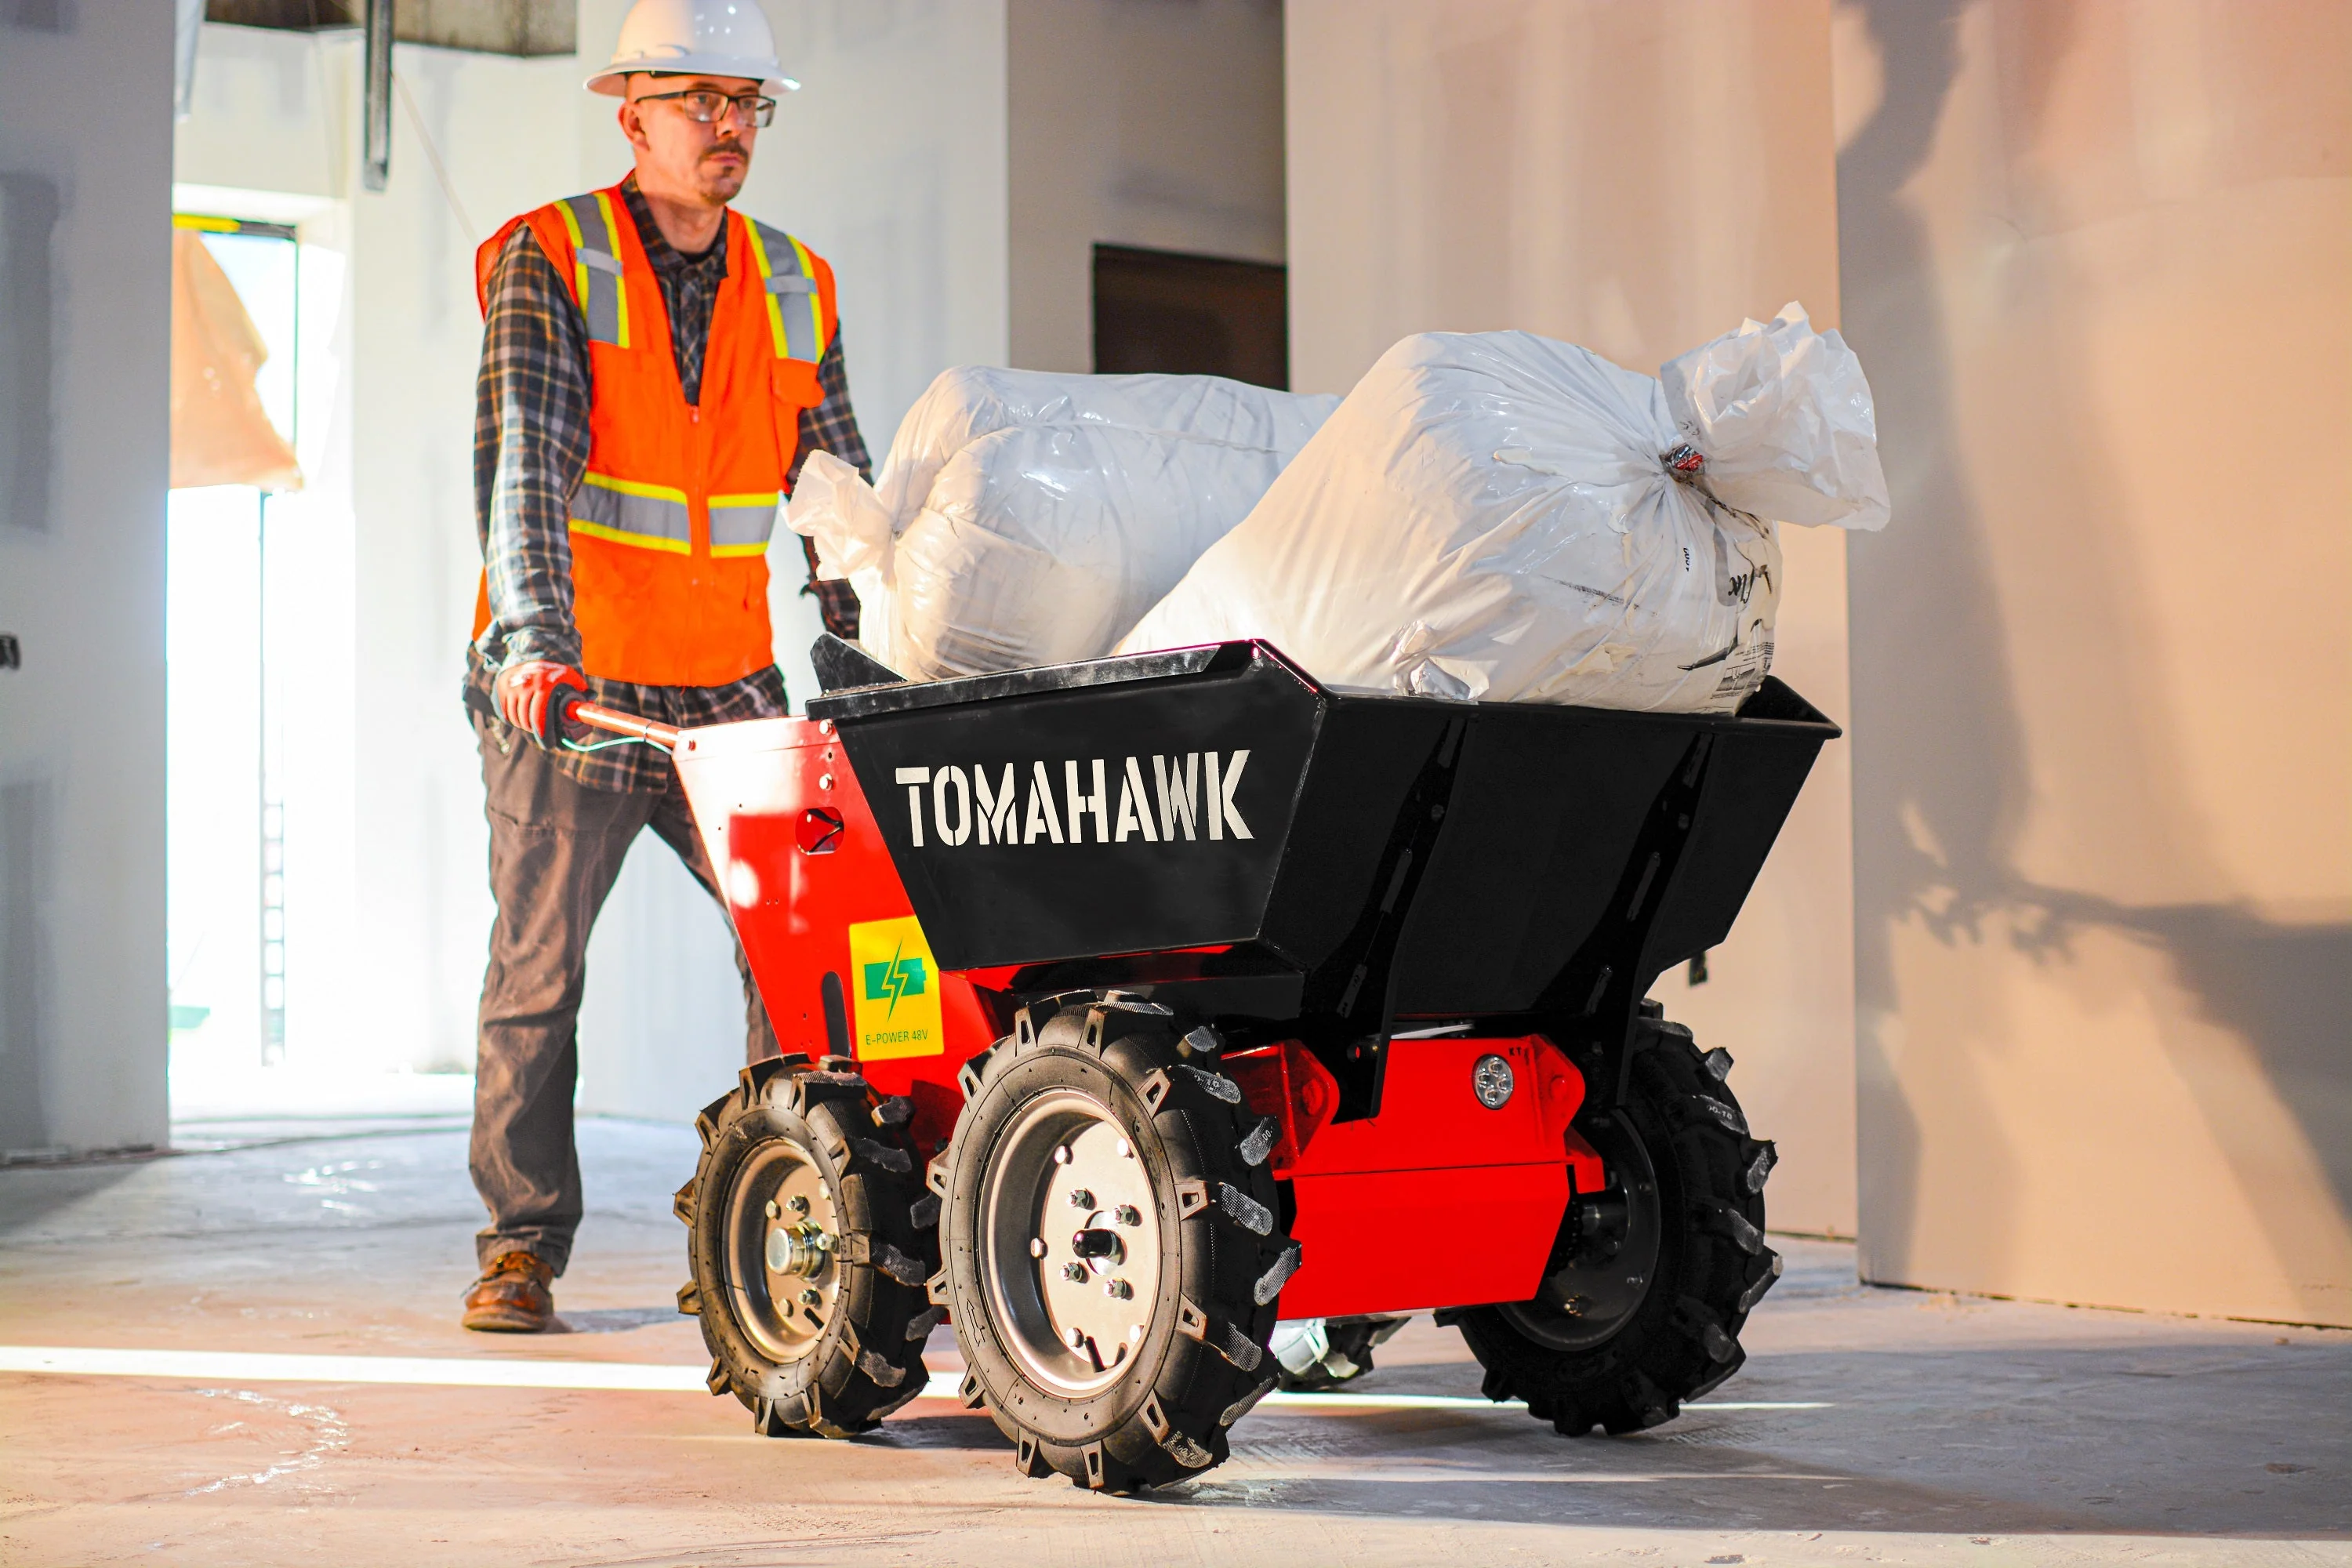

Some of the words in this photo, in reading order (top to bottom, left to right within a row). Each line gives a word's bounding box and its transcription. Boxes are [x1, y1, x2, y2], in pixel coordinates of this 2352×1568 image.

[895, 750, 1254, 848] TOMAHAWK
[866, 1031, 909, 1044] E-POWER
[912, 1029, 928, 1040] 48V
